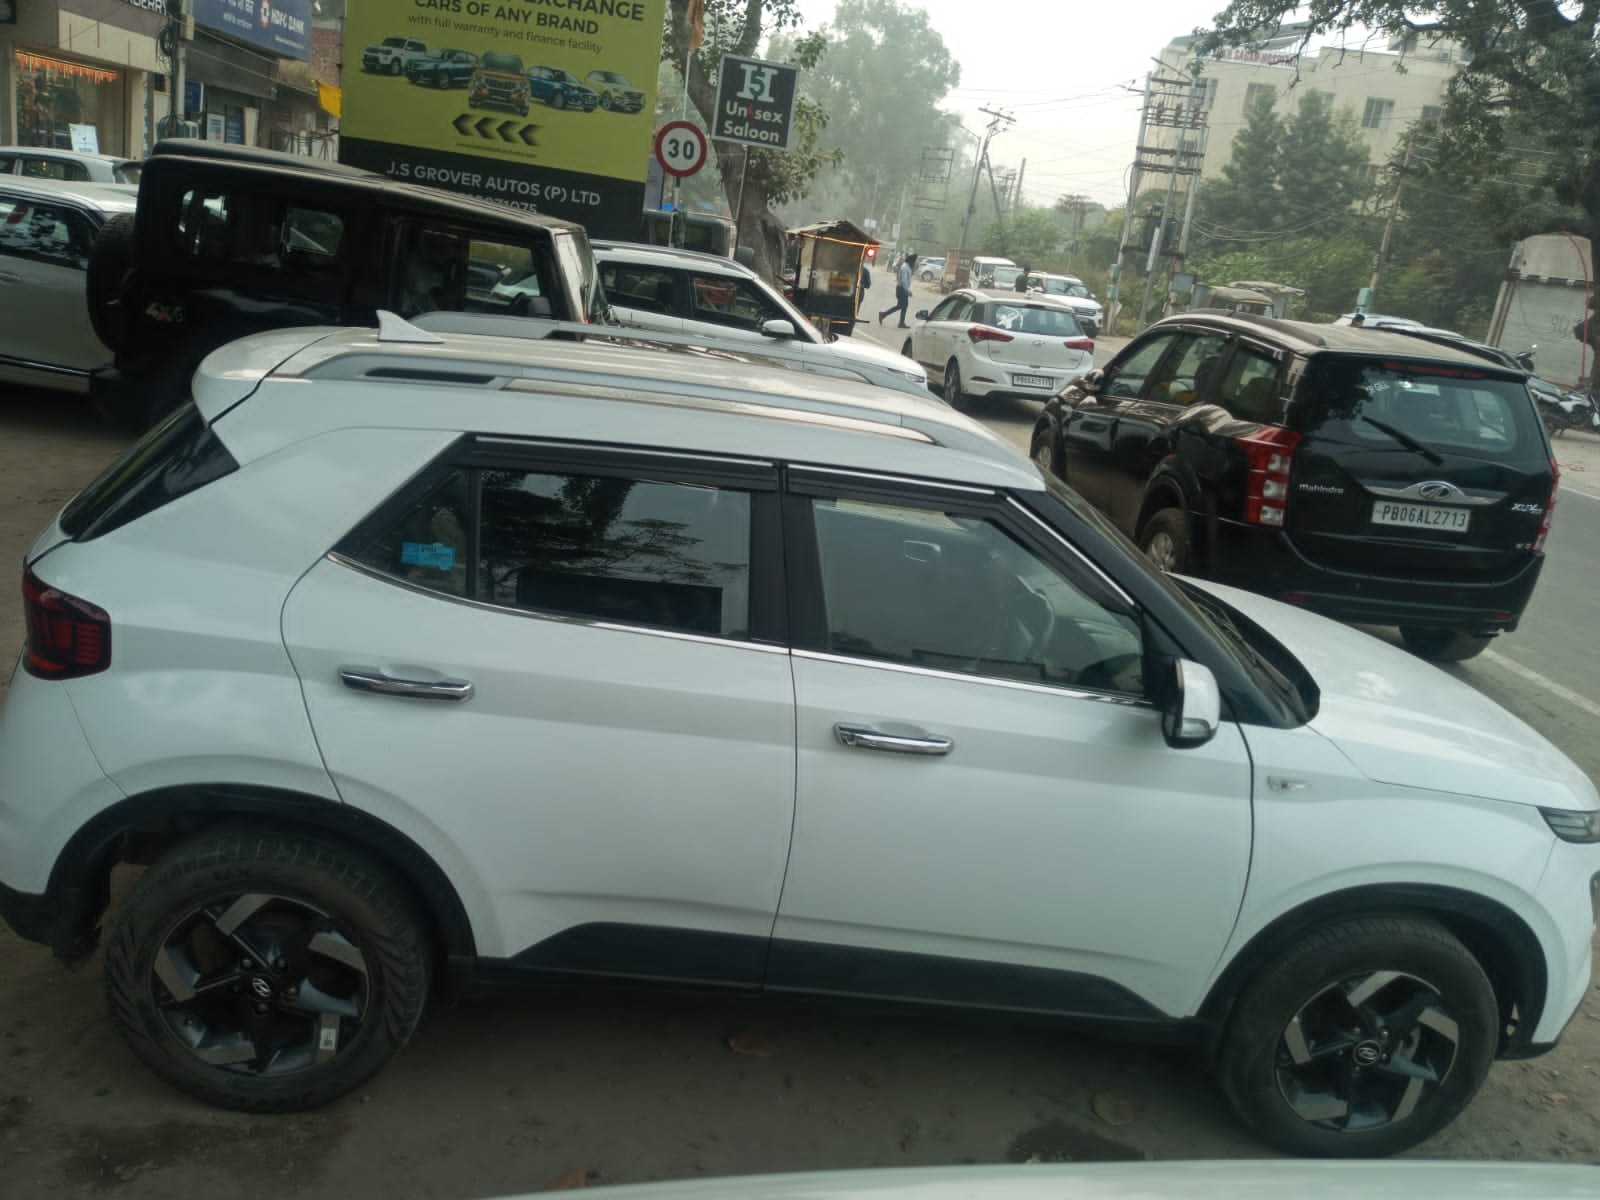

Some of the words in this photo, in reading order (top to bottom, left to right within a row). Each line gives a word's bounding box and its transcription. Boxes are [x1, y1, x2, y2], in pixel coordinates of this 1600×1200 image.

[415, 0, 461, 12] CARS
[466, 1, 490, 17] OF
[495, 6, 530, 24] ANY
[536, 12, 599, 34] BRAND
[408, 14, 432, 25] with
[434, 17, 452, 29] full
[453, 22, 499, 37] warranty
[503, 30, 524, 41] and
[526, 31, 566, 48] finance
[568, 37, 602, 55] facility
[726, 101, 783, 124] Unisex
[723, 120, 780, 143] Saloon
[667, 138, 696, 161] 30
[386, 161, 411, 178] J.S
[414, 164, 481, 188] GROVER
[485, 176, 541, 198] AUTOS
[544, 184, 567, 202] (P)
[570, 190, 601, 207] LTD
[1381, 503, 1467, 528] PB06AL2713
